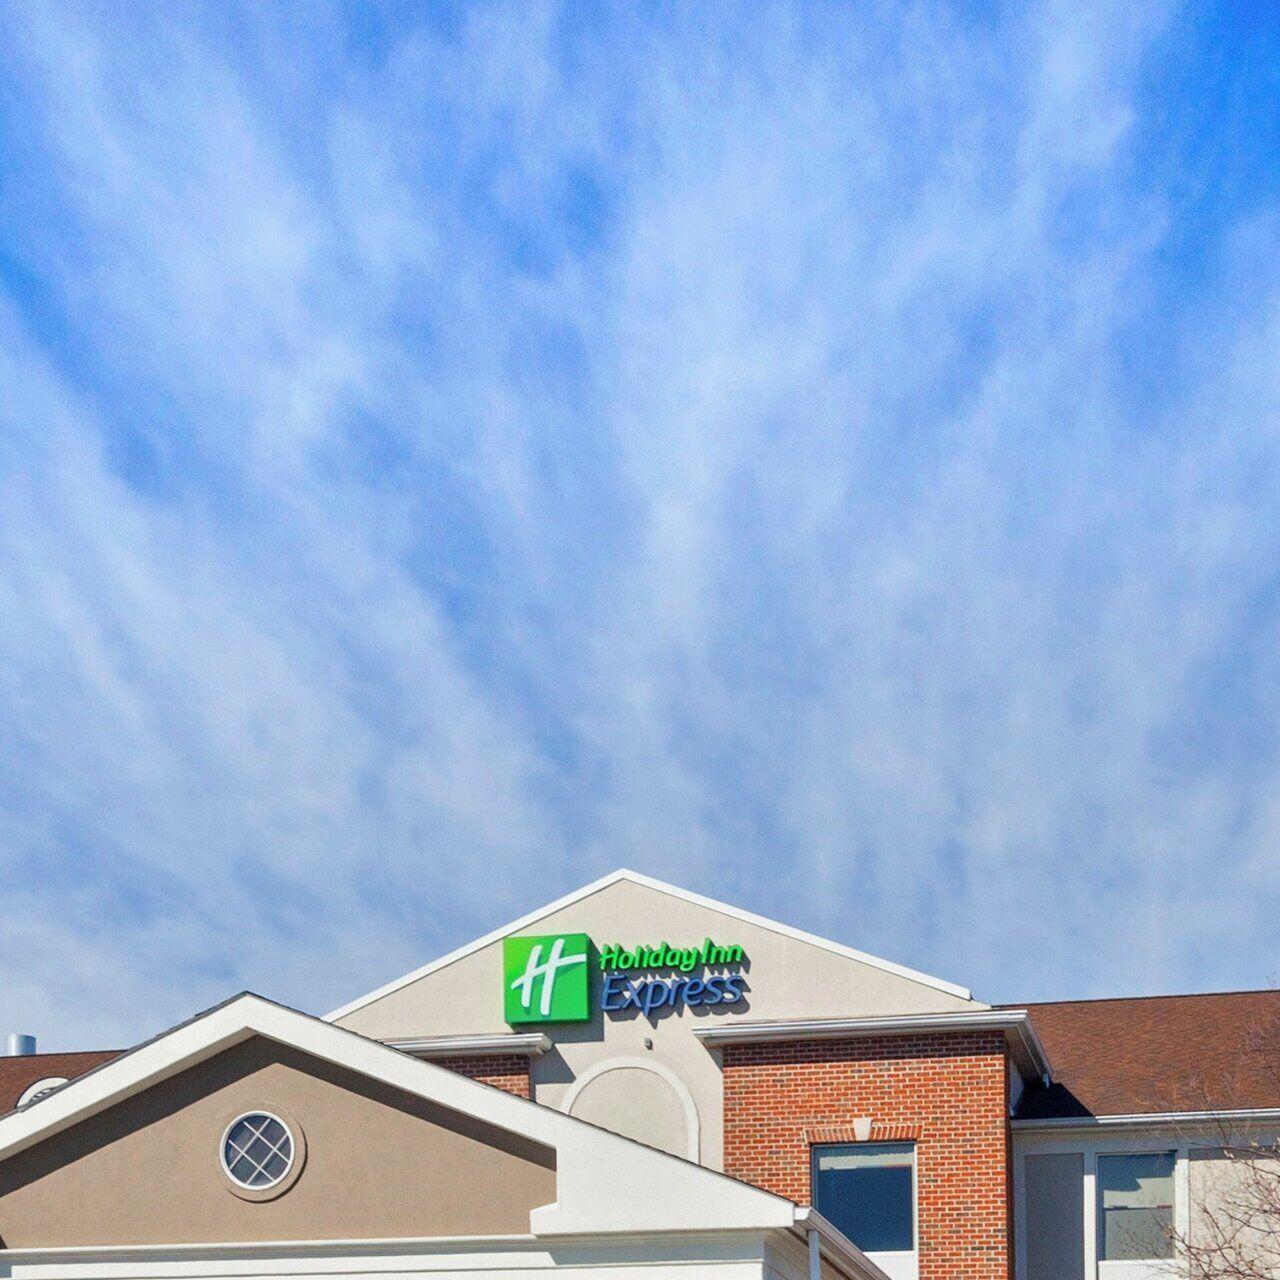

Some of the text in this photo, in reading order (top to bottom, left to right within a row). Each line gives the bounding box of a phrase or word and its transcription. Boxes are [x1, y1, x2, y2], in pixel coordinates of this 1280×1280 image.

[599, 937, 743, 972] Holiday Inn
[601, 974, 743, 1017] Express
